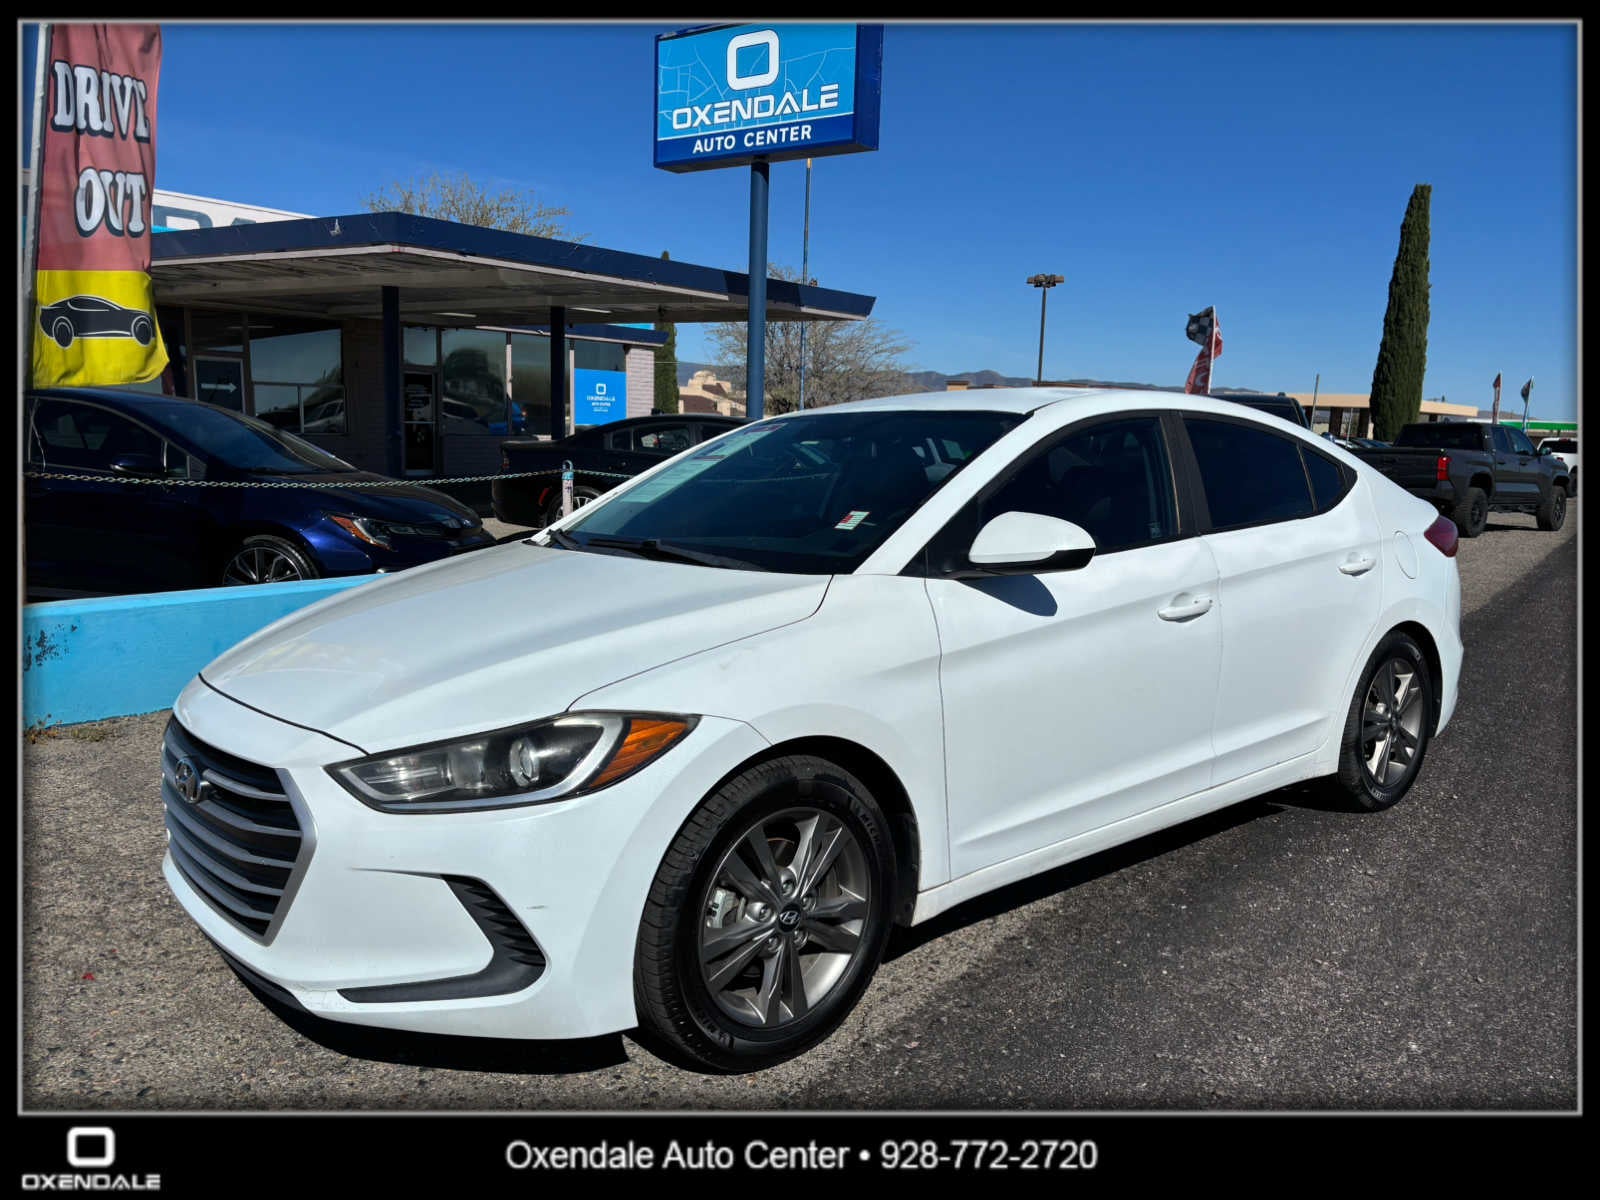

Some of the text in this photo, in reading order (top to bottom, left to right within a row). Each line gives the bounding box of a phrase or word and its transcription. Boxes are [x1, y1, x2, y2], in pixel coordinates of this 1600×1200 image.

[672, 83, 839, 130] OXENDALE
[692, 124, 812, 154] AUTO CENTER
[74, 167, 146, 237] OUT
